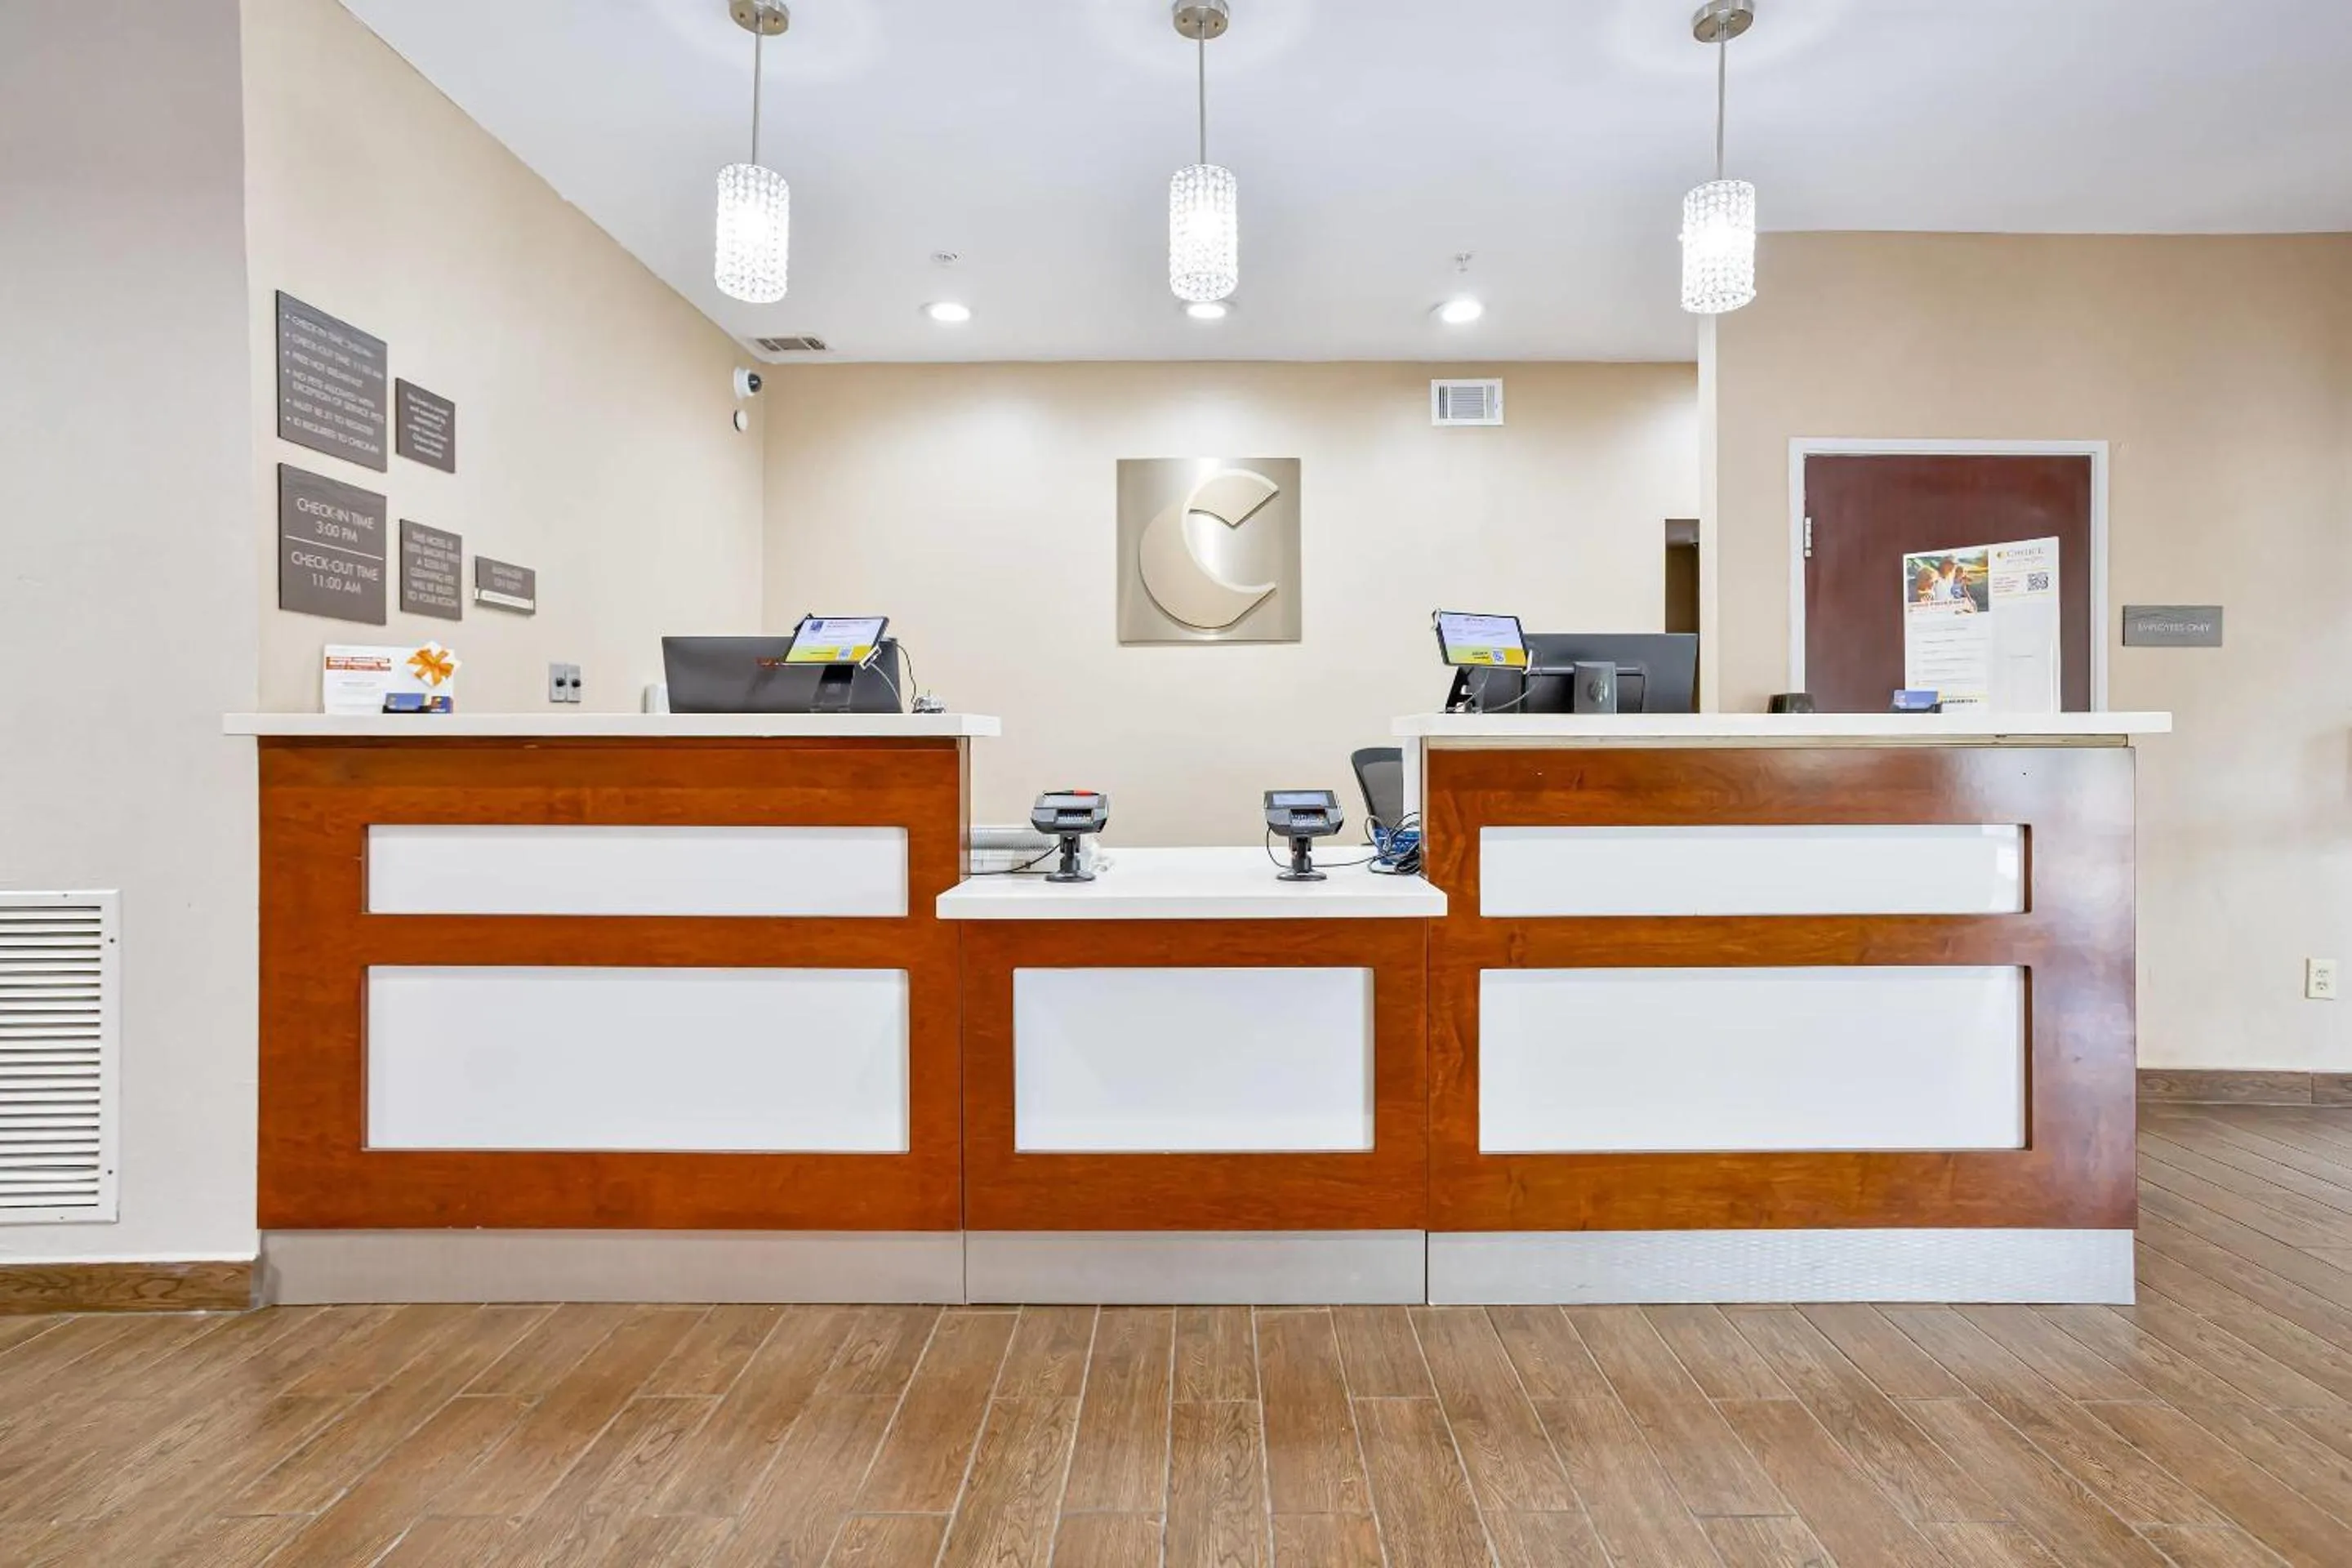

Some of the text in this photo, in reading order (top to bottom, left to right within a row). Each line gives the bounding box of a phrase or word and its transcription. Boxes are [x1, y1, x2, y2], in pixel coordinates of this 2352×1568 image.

[296, 497, 376, 530] CHECK-IN TIME
[315, 520, 358, 542] 3:00 PM
[291, 551, 379, 581] CHECK-OUT TIME
[312, 574, 361, 595] 11:00 AM
